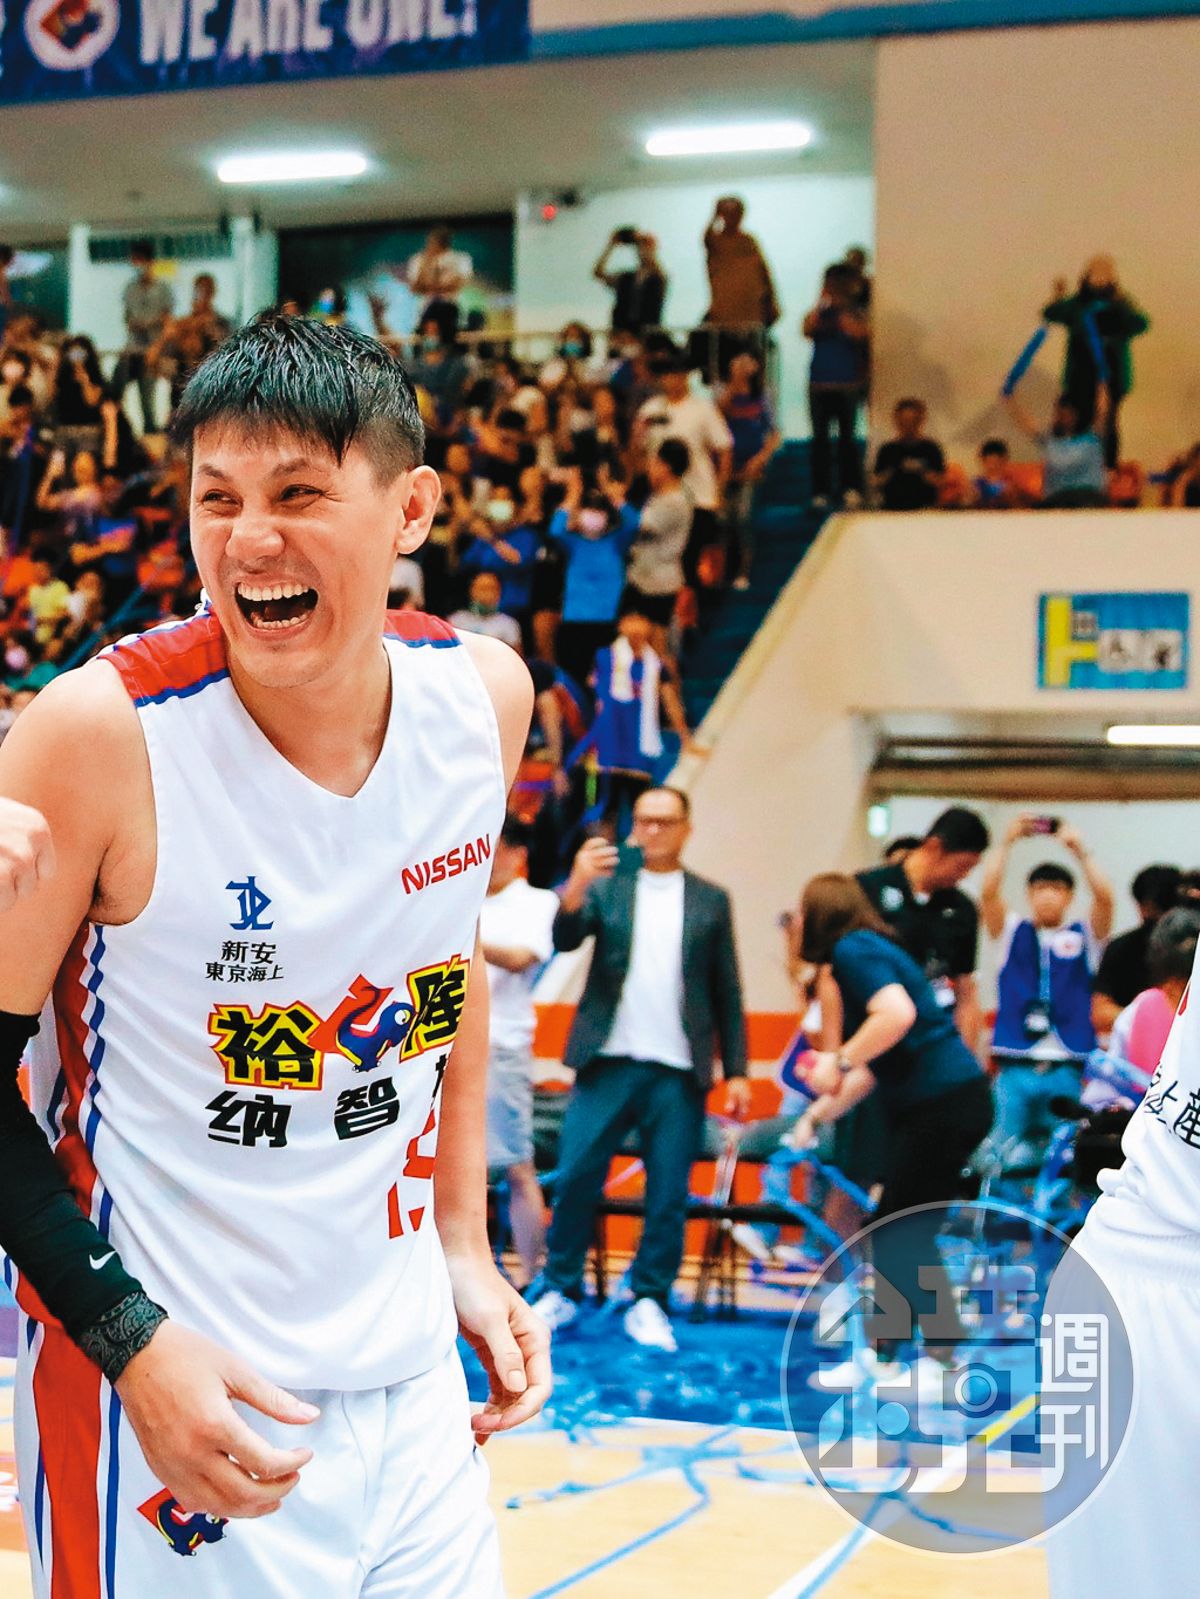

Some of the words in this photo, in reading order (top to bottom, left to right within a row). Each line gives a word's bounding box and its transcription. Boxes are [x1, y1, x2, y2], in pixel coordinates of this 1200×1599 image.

[400, 834, 490, 895] NISSAN
[221, 940, 277, 965] 新安
[205, 961, 284, 983] 東京海上
